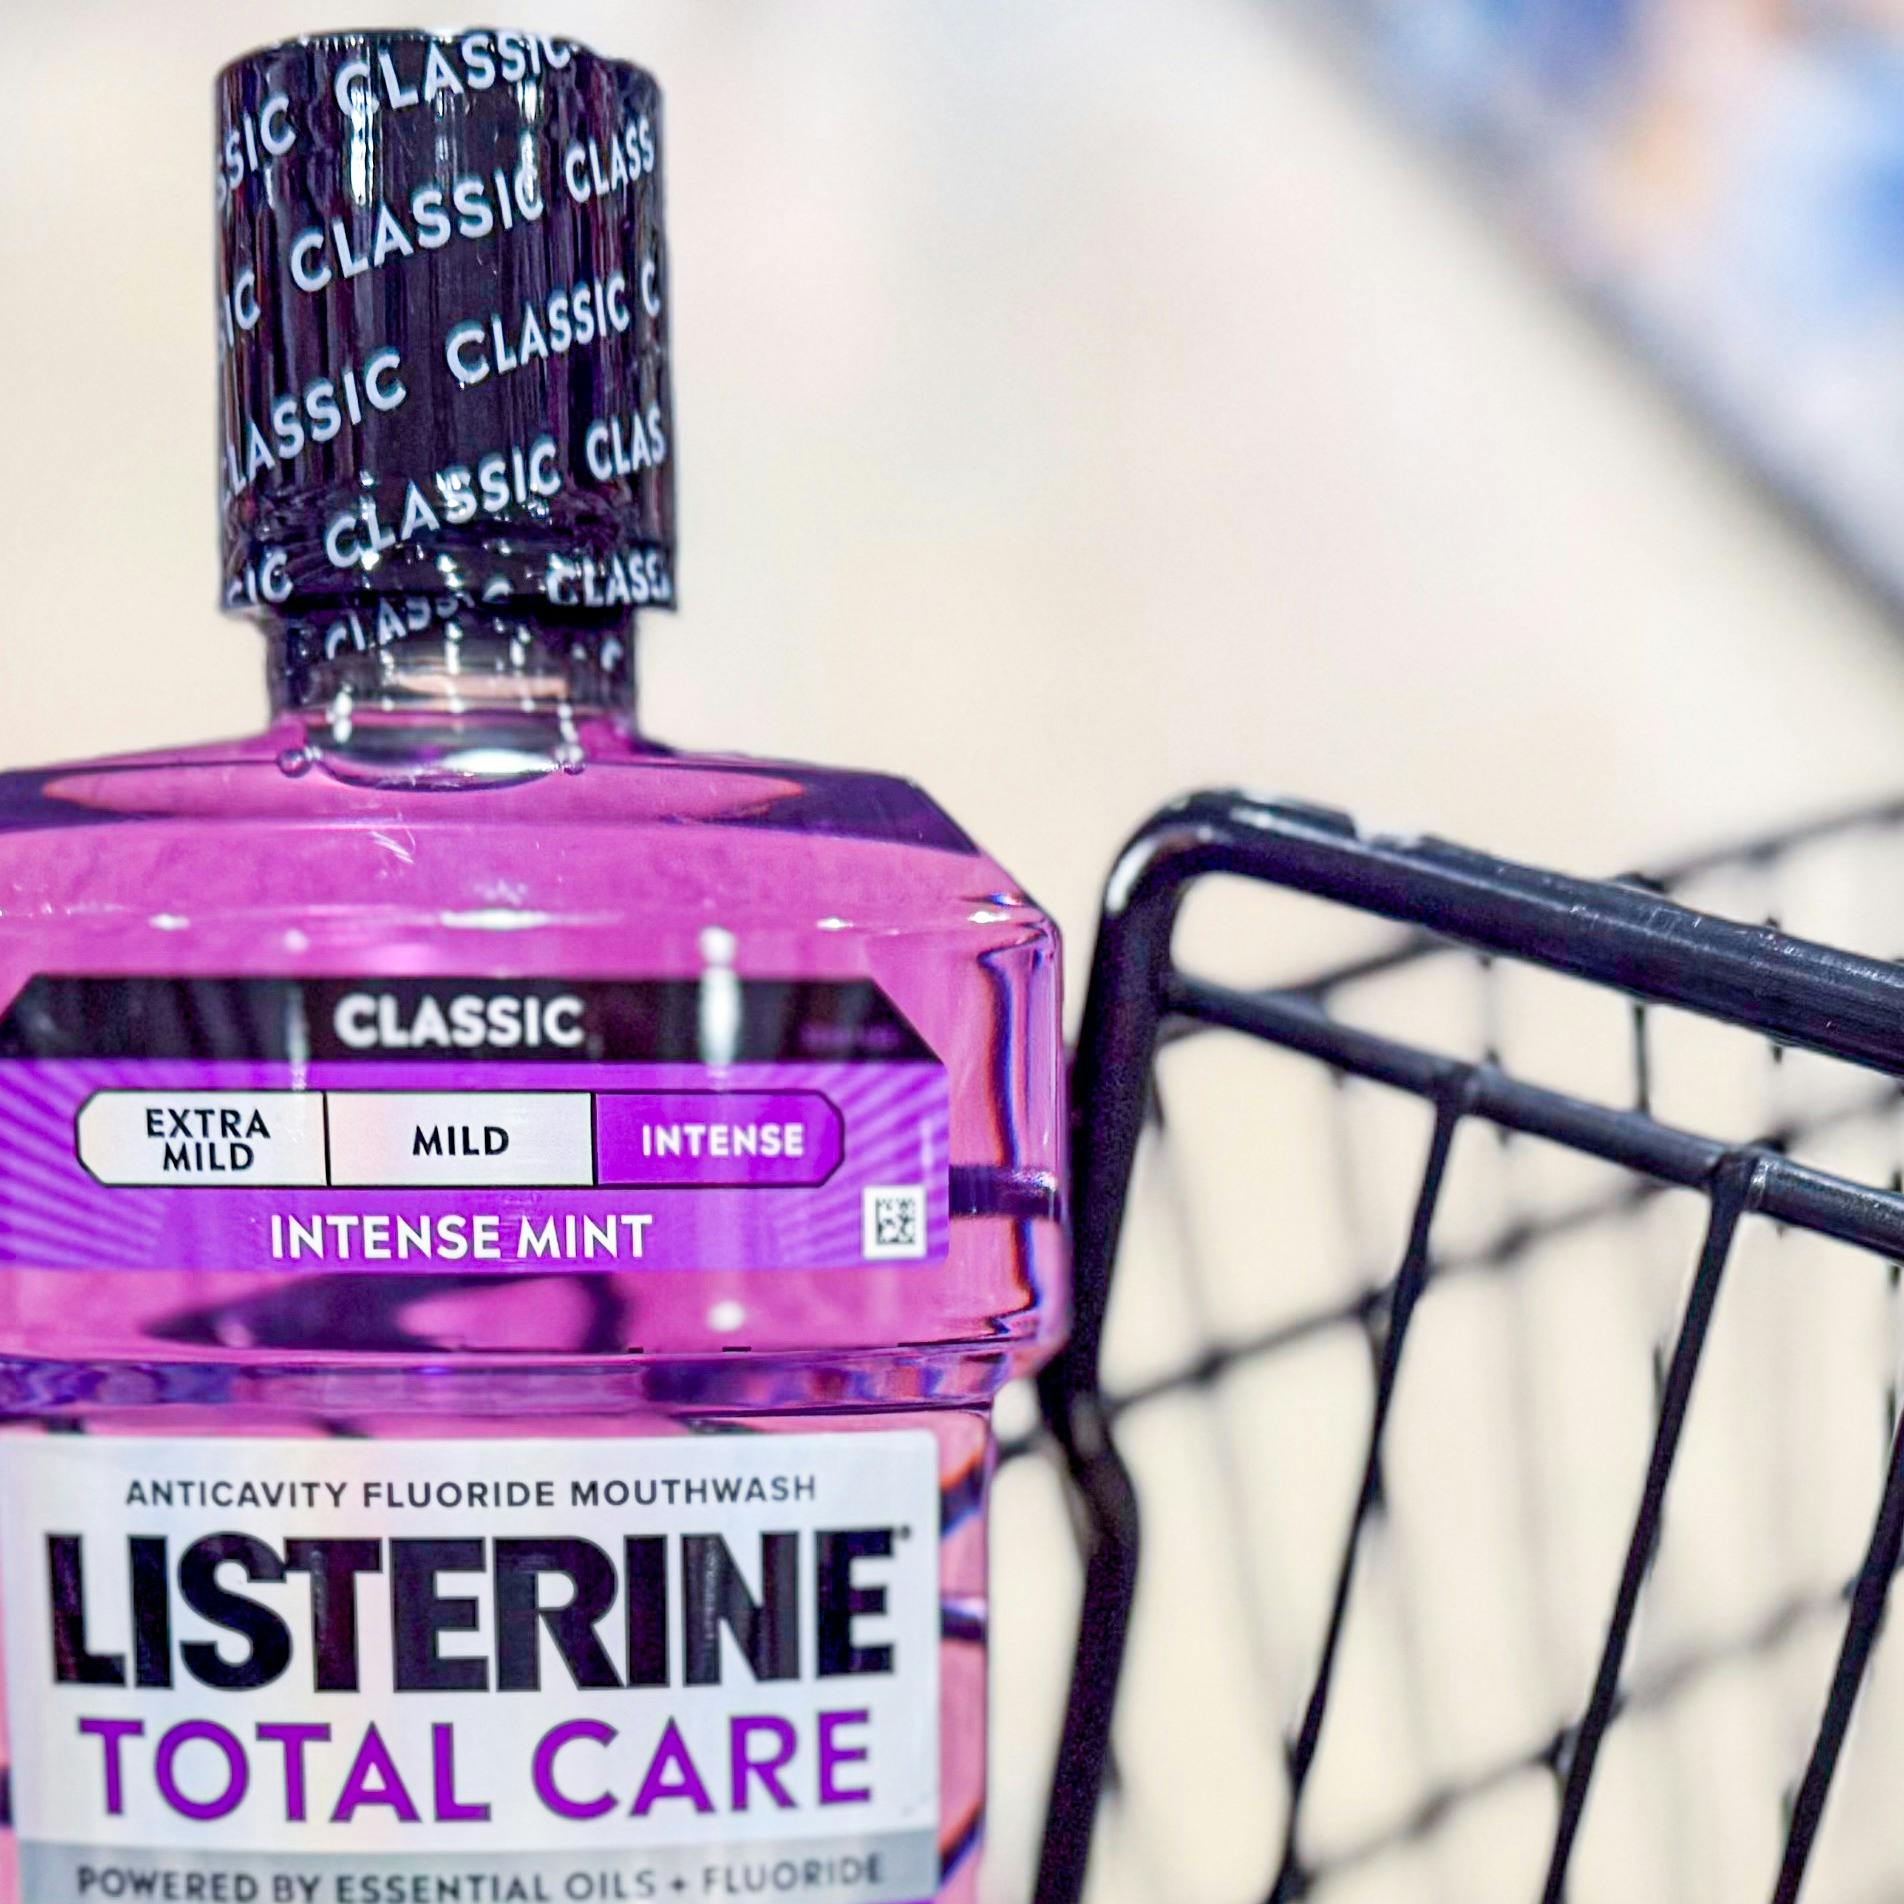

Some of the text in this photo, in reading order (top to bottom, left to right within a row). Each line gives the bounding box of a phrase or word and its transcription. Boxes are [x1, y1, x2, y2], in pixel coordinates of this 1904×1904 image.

[335, 34, 578, 117] CLASSIC
[291, 163, 546, 292] CLASSIC
[445, 268, 632, 387] CLASSIC
[324, 434, 562, 569] CLASSIC
[332, 992, 585, 1048] CLASSIC
[145, 1108, 272, 1142] EXTRA
[412, 1125, 510, 1157] MILD
[640, 1122, 805, 1157] INTENSE
[161, 1141, 256, 1173] MILD
[271, 1214, 653, 1259] INTENSE MINT
[125, 1474, 817, 1510] ANTICAVITY FLUORIDE MOUTHWASH
[43, 1527, 899, 1695] LISTERINE
[77, 1707, 875, 1824] TOTAL CARE
[76, 1865, 259, 1904] POWERED
[563, 1868, 656, 1902] OILS
[670, 1876, 688, 1897] +
[702, 1855, 885, 1896] FLUORIDE
